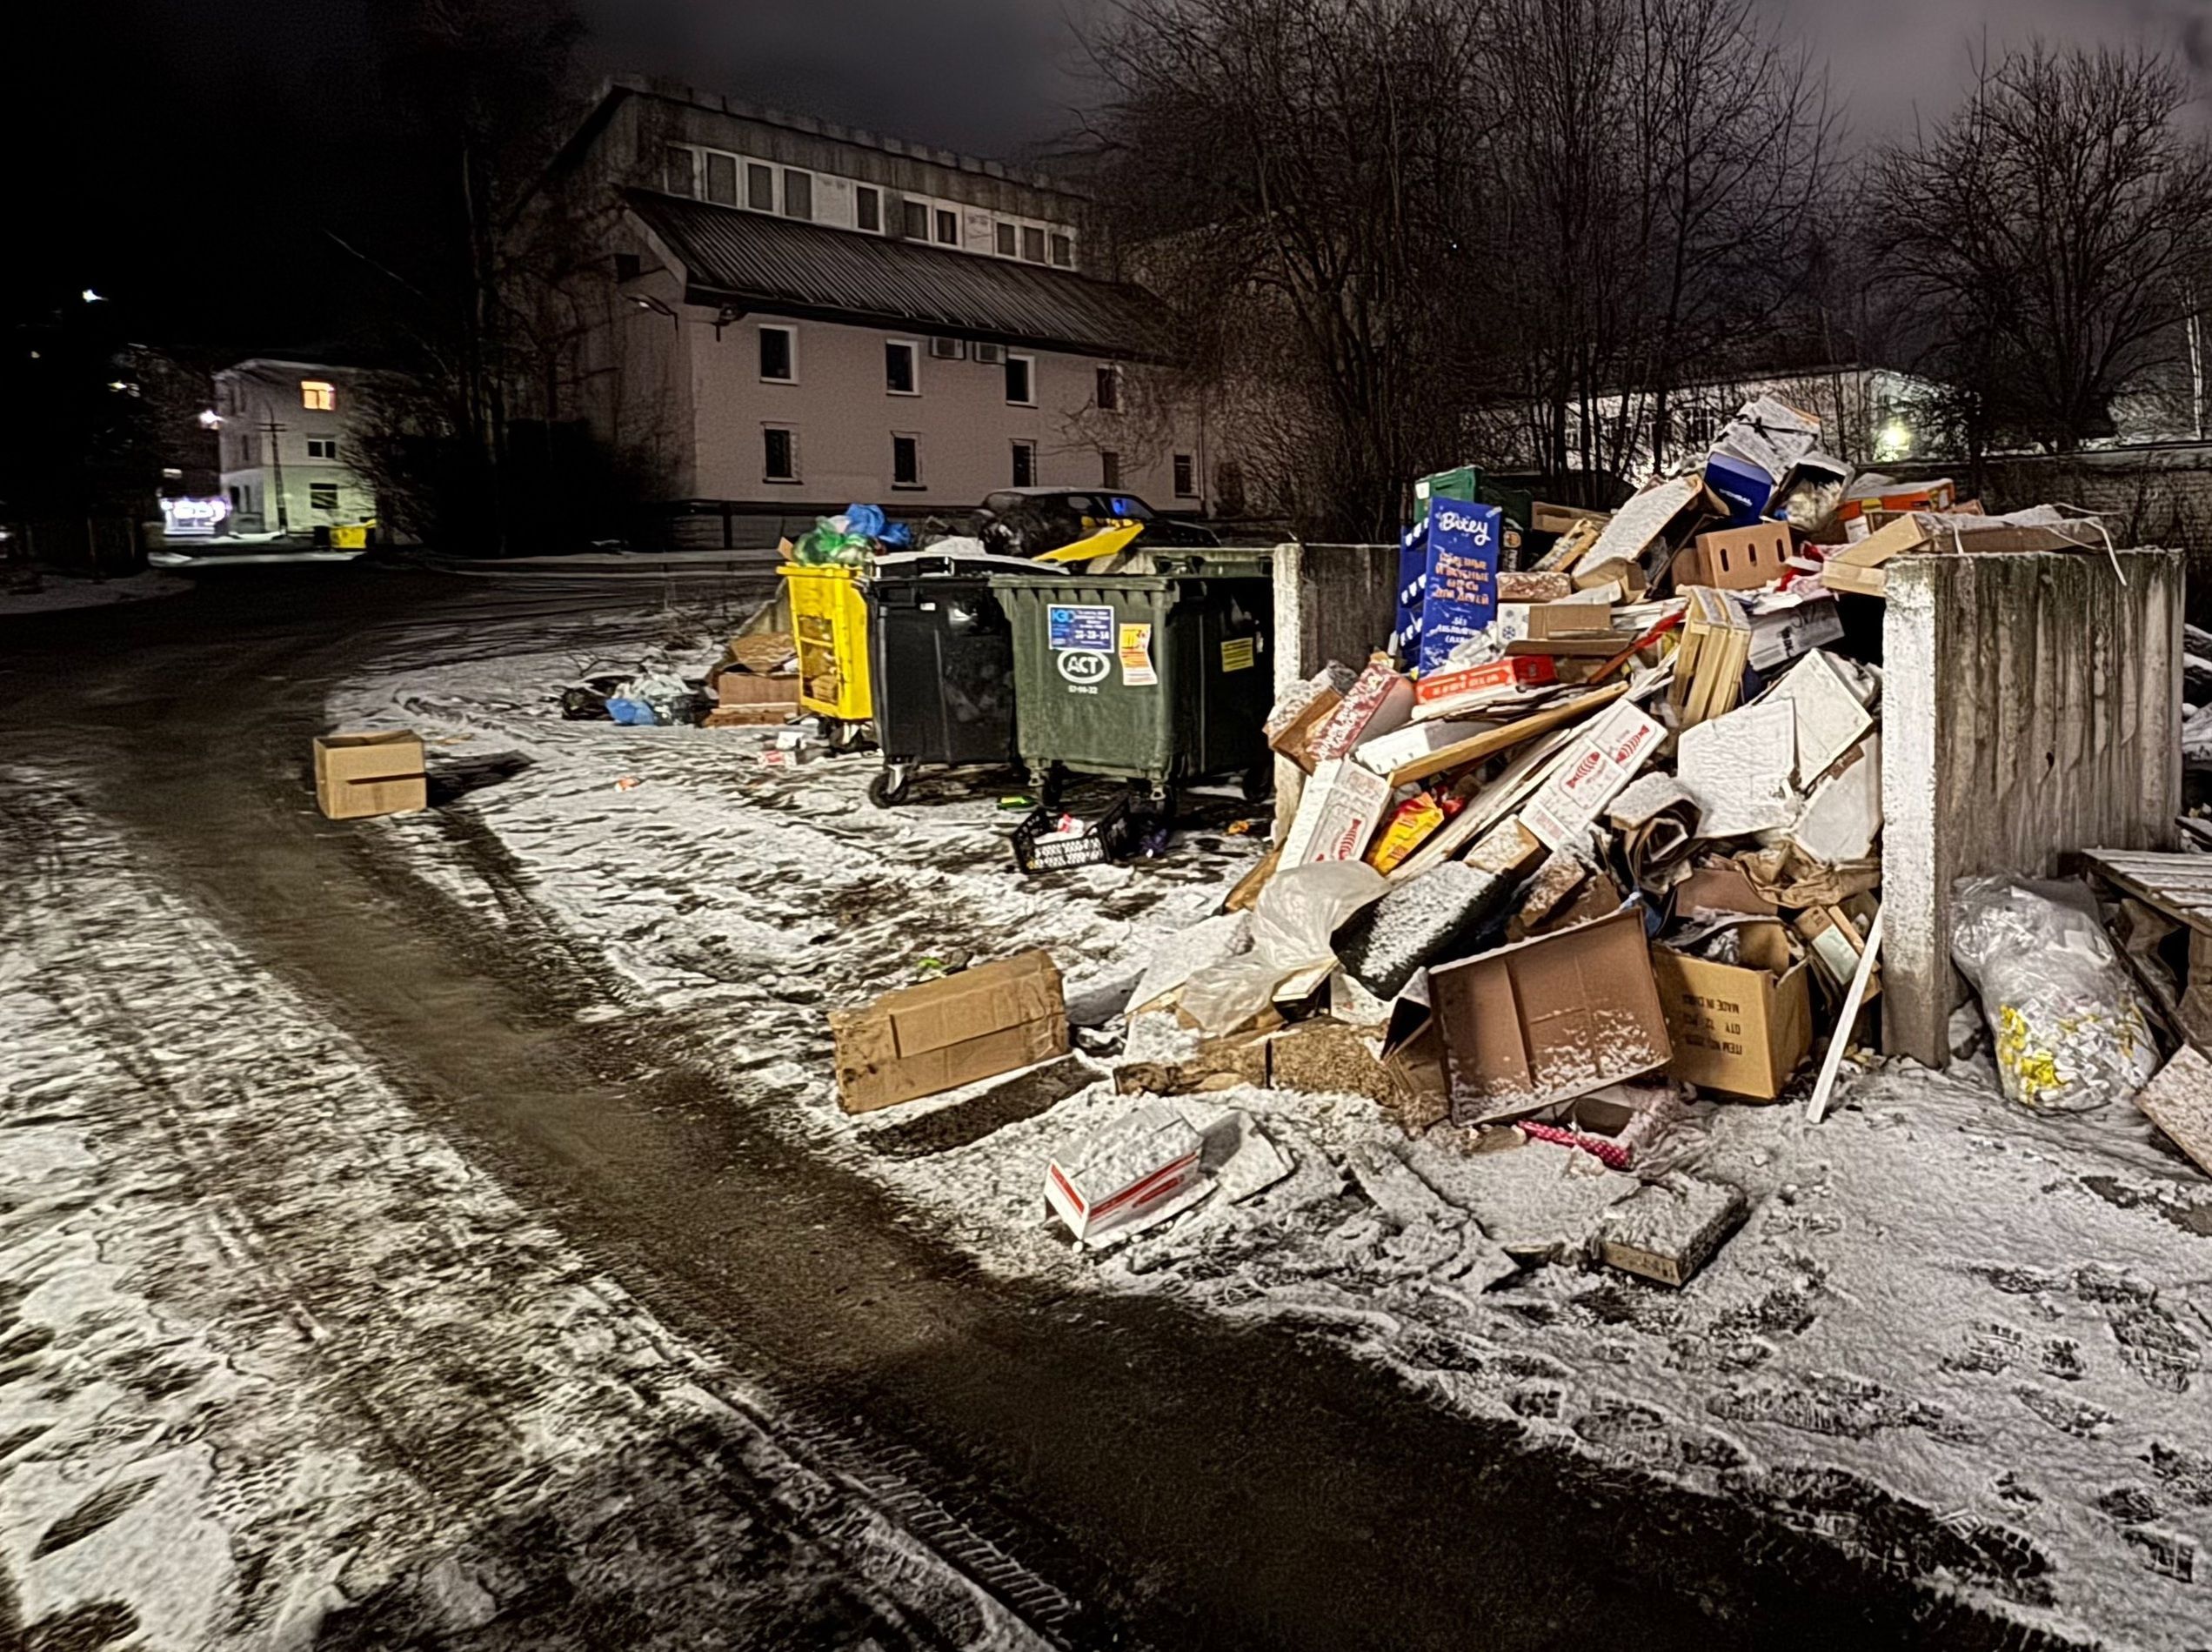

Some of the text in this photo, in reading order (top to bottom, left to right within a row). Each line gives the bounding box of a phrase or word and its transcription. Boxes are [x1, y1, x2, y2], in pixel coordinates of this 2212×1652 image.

[1706, 998, 1715, 1010] IN
[1716, 999, 1740, 1014] MADE
[1725, 1022, 1741, 1035] QTY
[1722, 1042, 1742, 1055] ITEM
